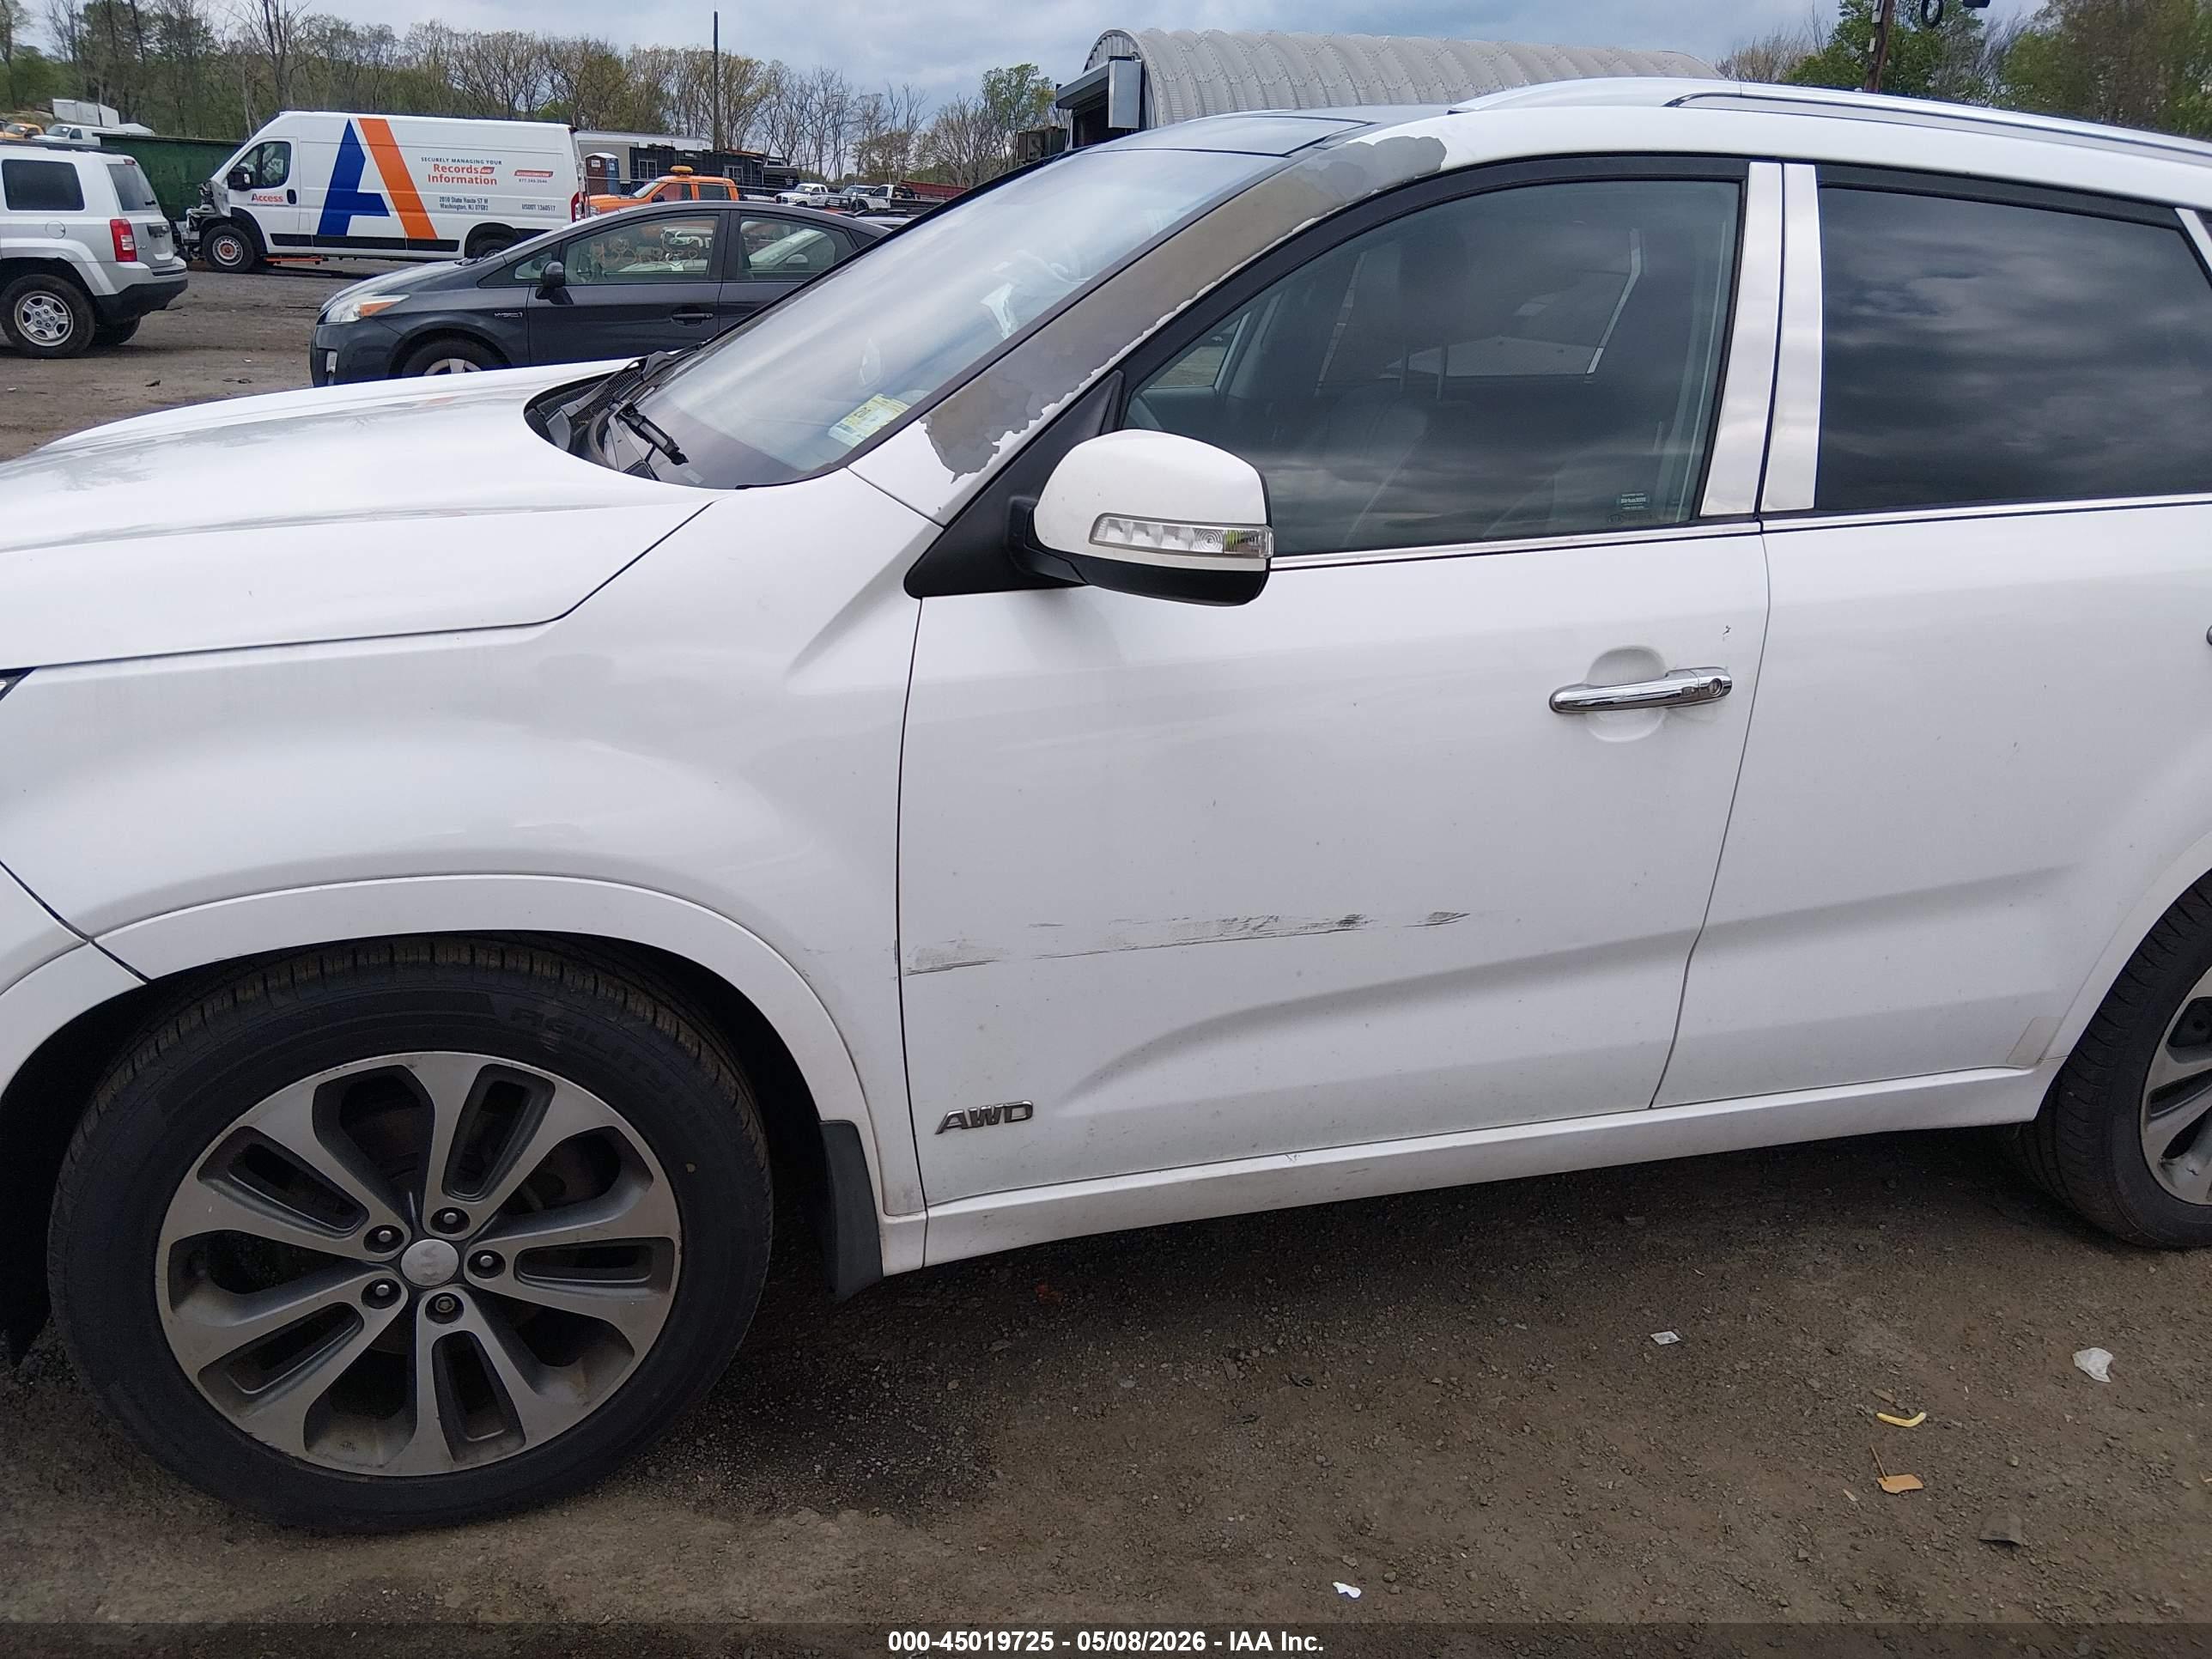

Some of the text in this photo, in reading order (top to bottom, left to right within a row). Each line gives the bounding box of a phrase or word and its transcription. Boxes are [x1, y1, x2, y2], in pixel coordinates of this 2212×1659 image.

[433, 163, 478, 174] Records
[428, 174, 497, 185] Information
[251, 193, 283, 203] Access
[934, 1100, 1034, 1134] AWD
